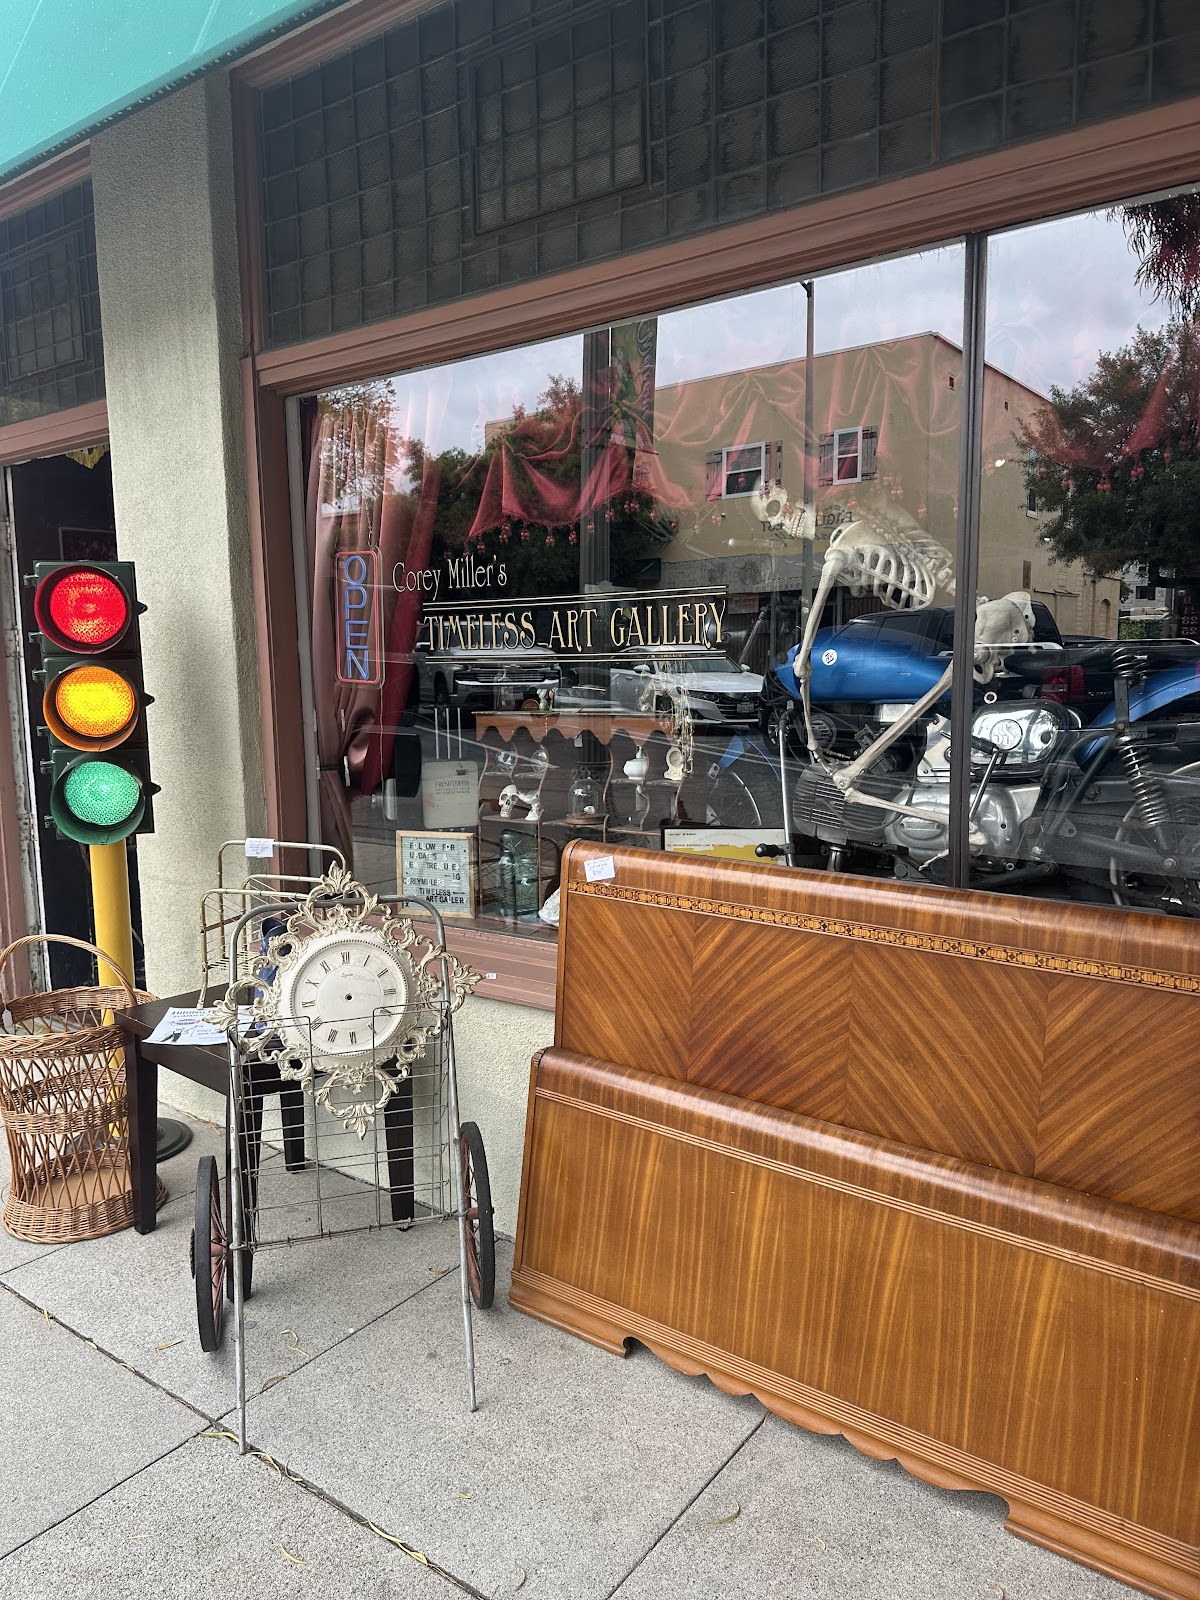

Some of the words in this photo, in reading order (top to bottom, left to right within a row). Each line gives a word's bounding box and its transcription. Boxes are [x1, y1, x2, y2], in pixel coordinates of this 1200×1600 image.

[392, 562, 441, 602] Corey
[447, 554, 508, 589] Miller's
[343, 554, 369, 681] OPEN
[423, 610, 536, 651] TIMELESS
[549, 608, 597, 653] ART
[610, 600, 727, 650] GALLERY
[409, 842, 436, 851] FOLLOW
[442, 843, 455, 851] FOR
[409, 851, 438, 860] UPDATES
[418, 887, 451, 897] TIMELESS
